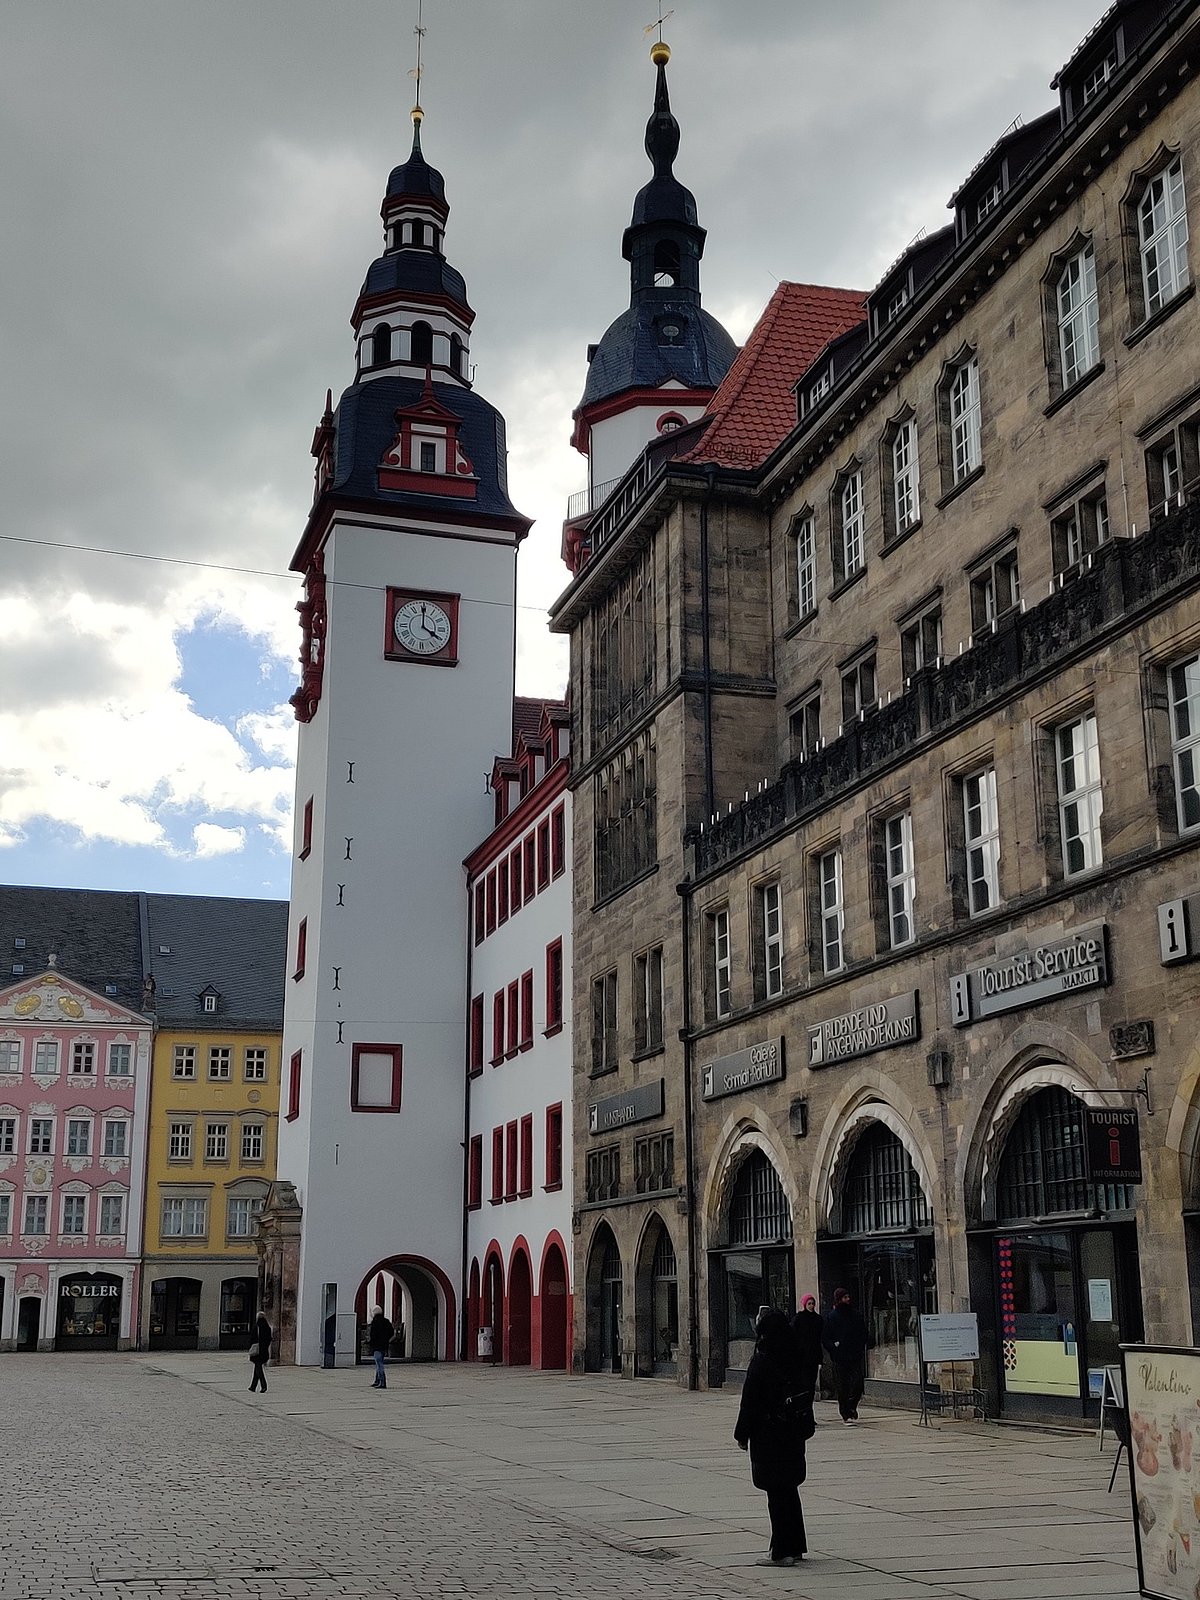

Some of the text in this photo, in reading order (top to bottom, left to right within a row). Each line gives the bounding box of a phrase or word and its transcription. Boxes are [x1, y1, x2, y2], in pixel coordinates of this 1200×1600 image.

[977, 934, 1097, 996] Tourist Service
[1061, 970, 1091, 990] MARKT
[865, 1004, 887, 1027] UND
[1089, 1112, 1136, 1125] TOURIST
[1093, 1169, 1141, 1178] INFORMATION
[60, 1285, 119, 1298] ROLLER
[1138, 1362, 1192, 1395] Valentino
